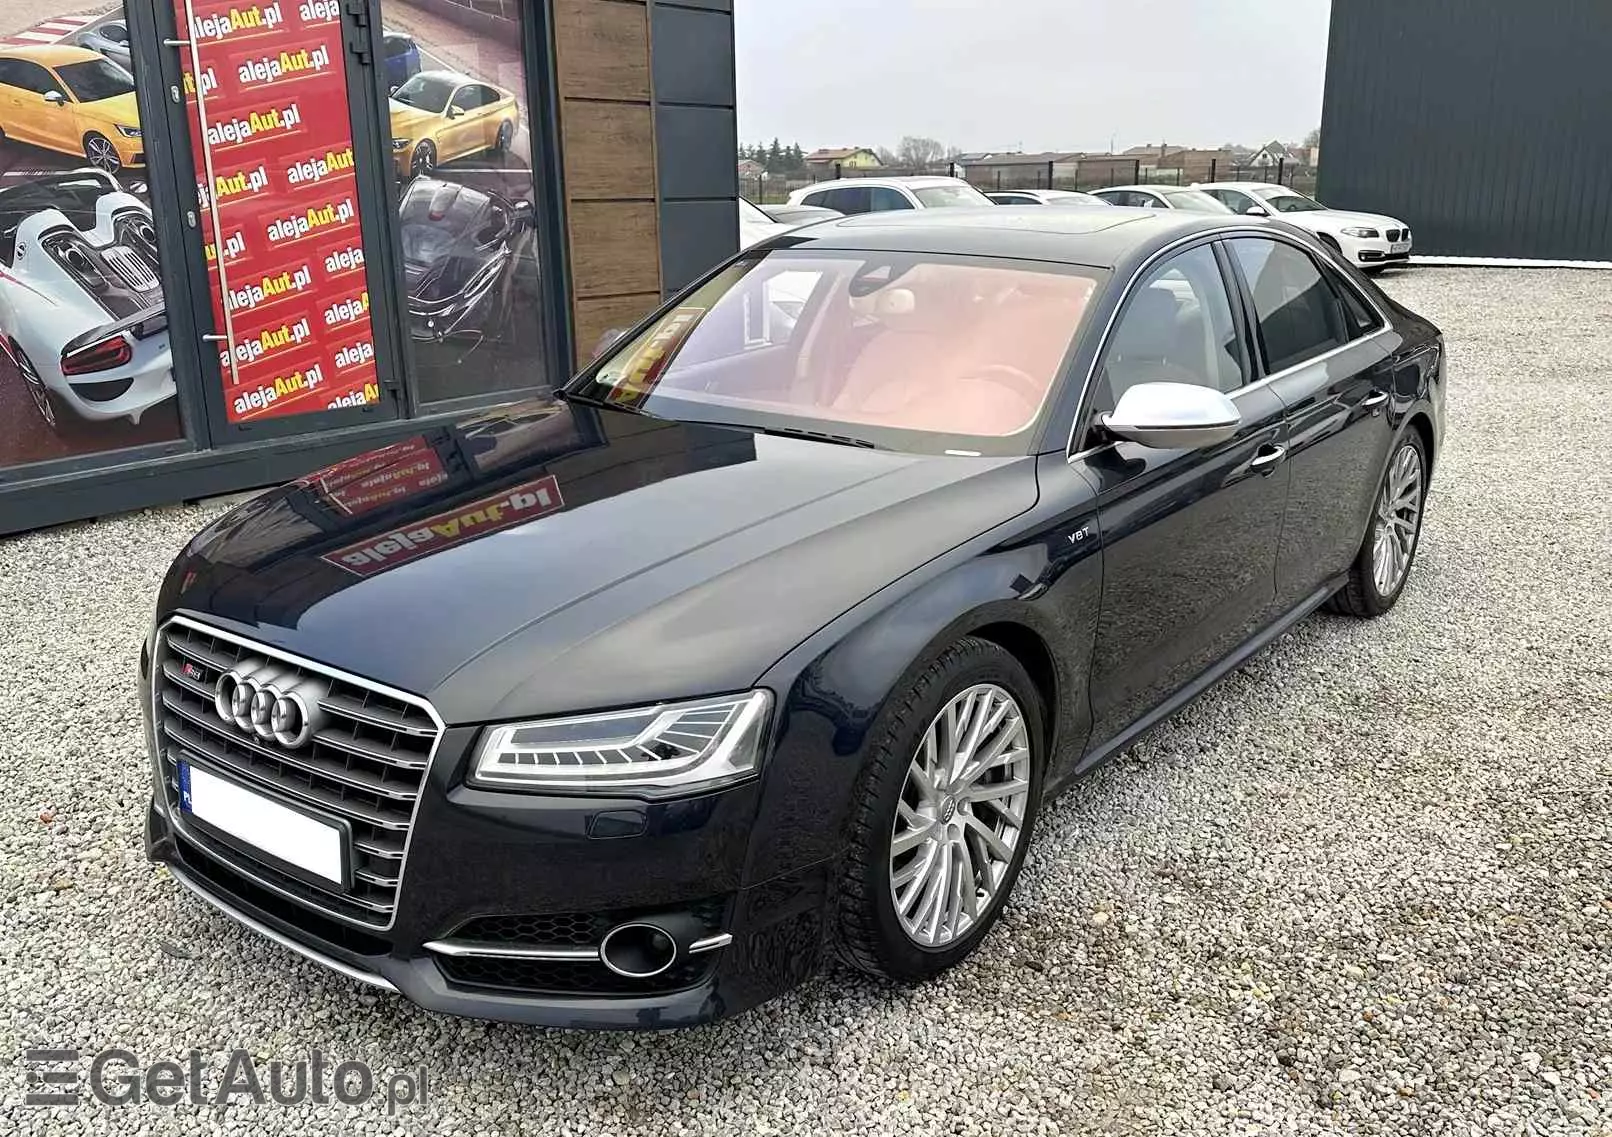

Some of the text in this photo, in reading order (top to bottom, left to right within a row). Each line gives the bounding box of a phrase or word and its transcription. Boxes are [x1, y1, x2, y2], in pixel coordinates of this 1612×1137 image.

[299, 0, 340, 21] aleja
[238, 45, 329, 83] alejaAut.pl
[207, 104, 300, 145] alejaAut.pl
[267, 199, 354, 242] alejaAut.pl
[324, 246, 364, 273] aleja
[221, 265, 312, 311] lejaAut.pl
[219, 318, 311, 368] aejaAut.pl
[234, 363, 323, 415] alejaAut.pl
